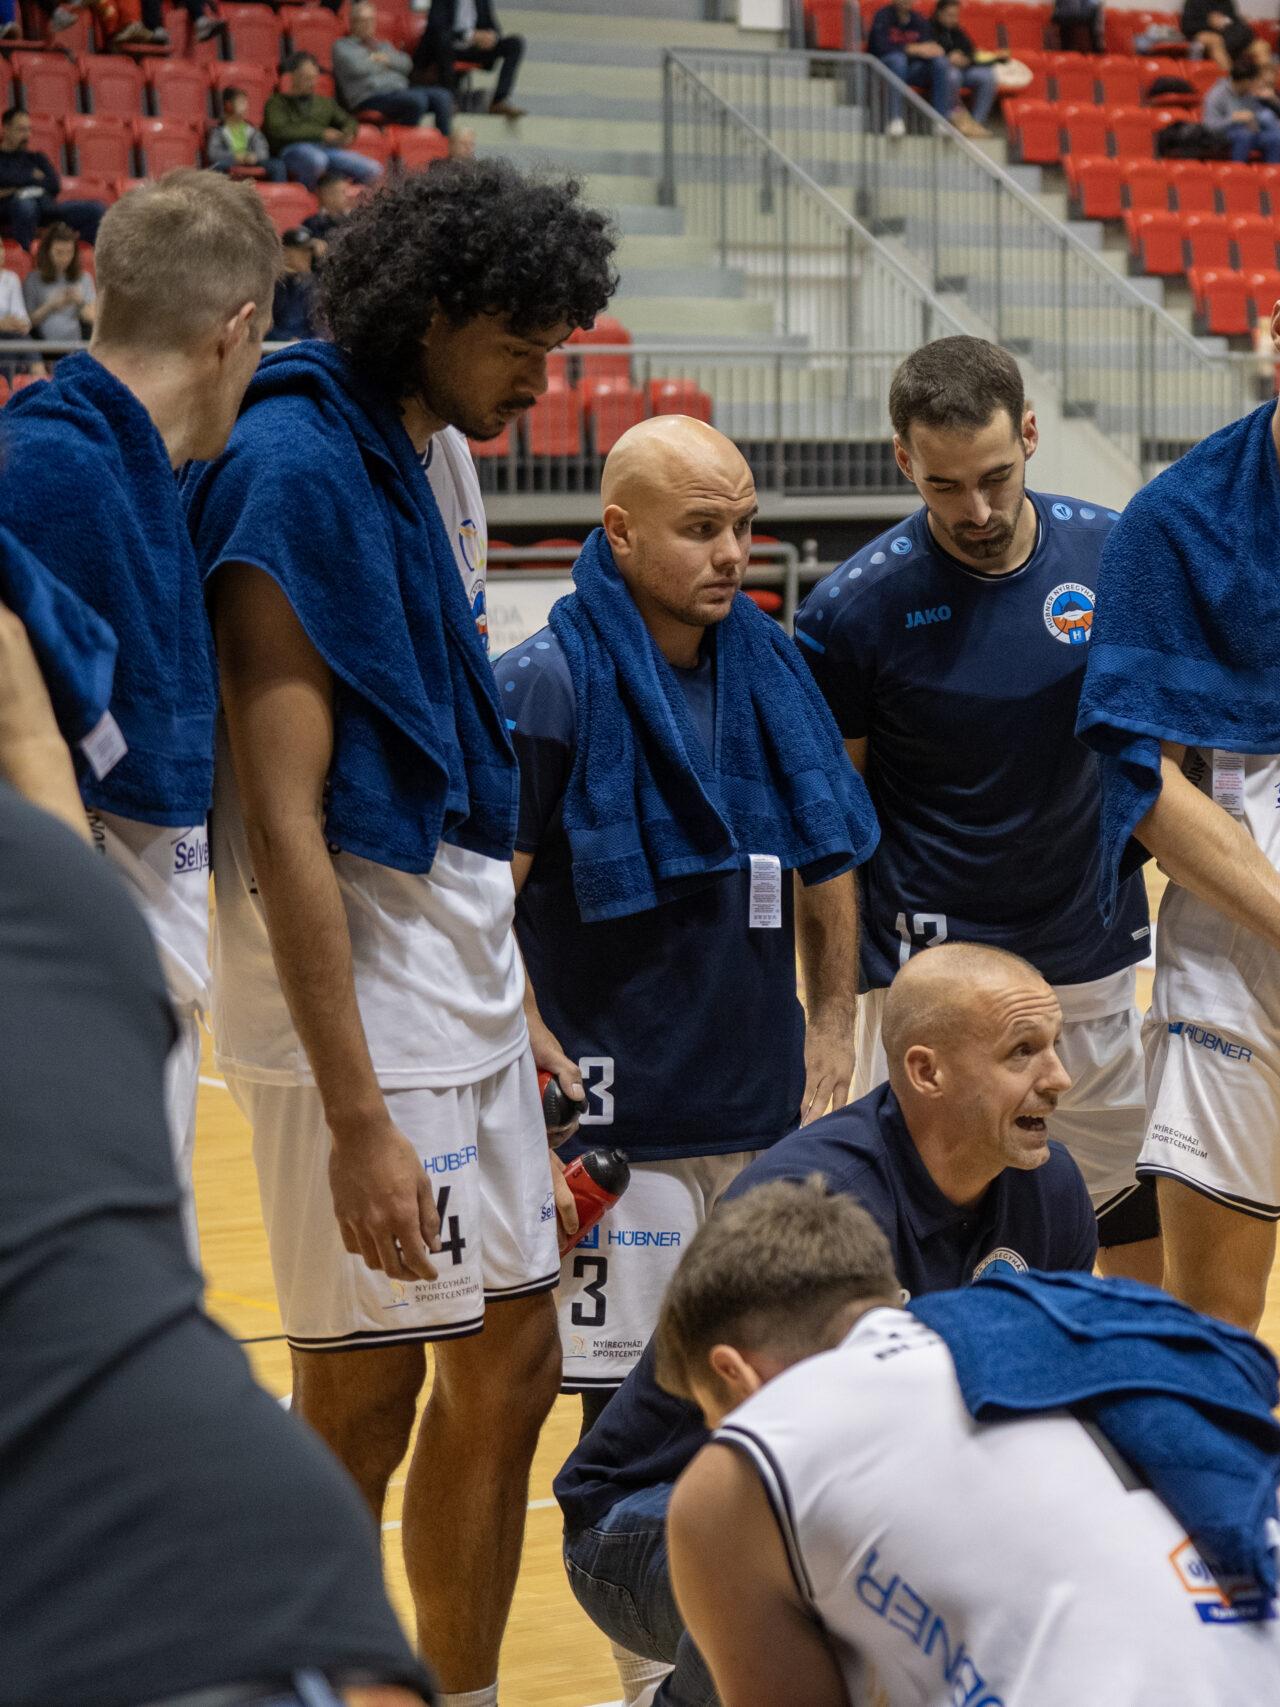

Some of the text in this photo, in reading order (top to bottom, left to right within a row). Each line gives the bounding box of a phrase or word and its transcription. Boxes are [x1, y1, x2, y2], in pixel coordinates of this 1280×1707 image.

[905, 604, 952, 630] JAKO
[1184, 1025, 1252, 1063] HÜBNER
[579, 1056, 615, 1126] 3
[1151, 1133, 1208, 1160] SPORTCENTRUM
[607, 1230, 681, 1248] HÜBNER
[571, 1255, 608, 1327] 3
[592, 1349, 644, 1358] SPORTCENTR
